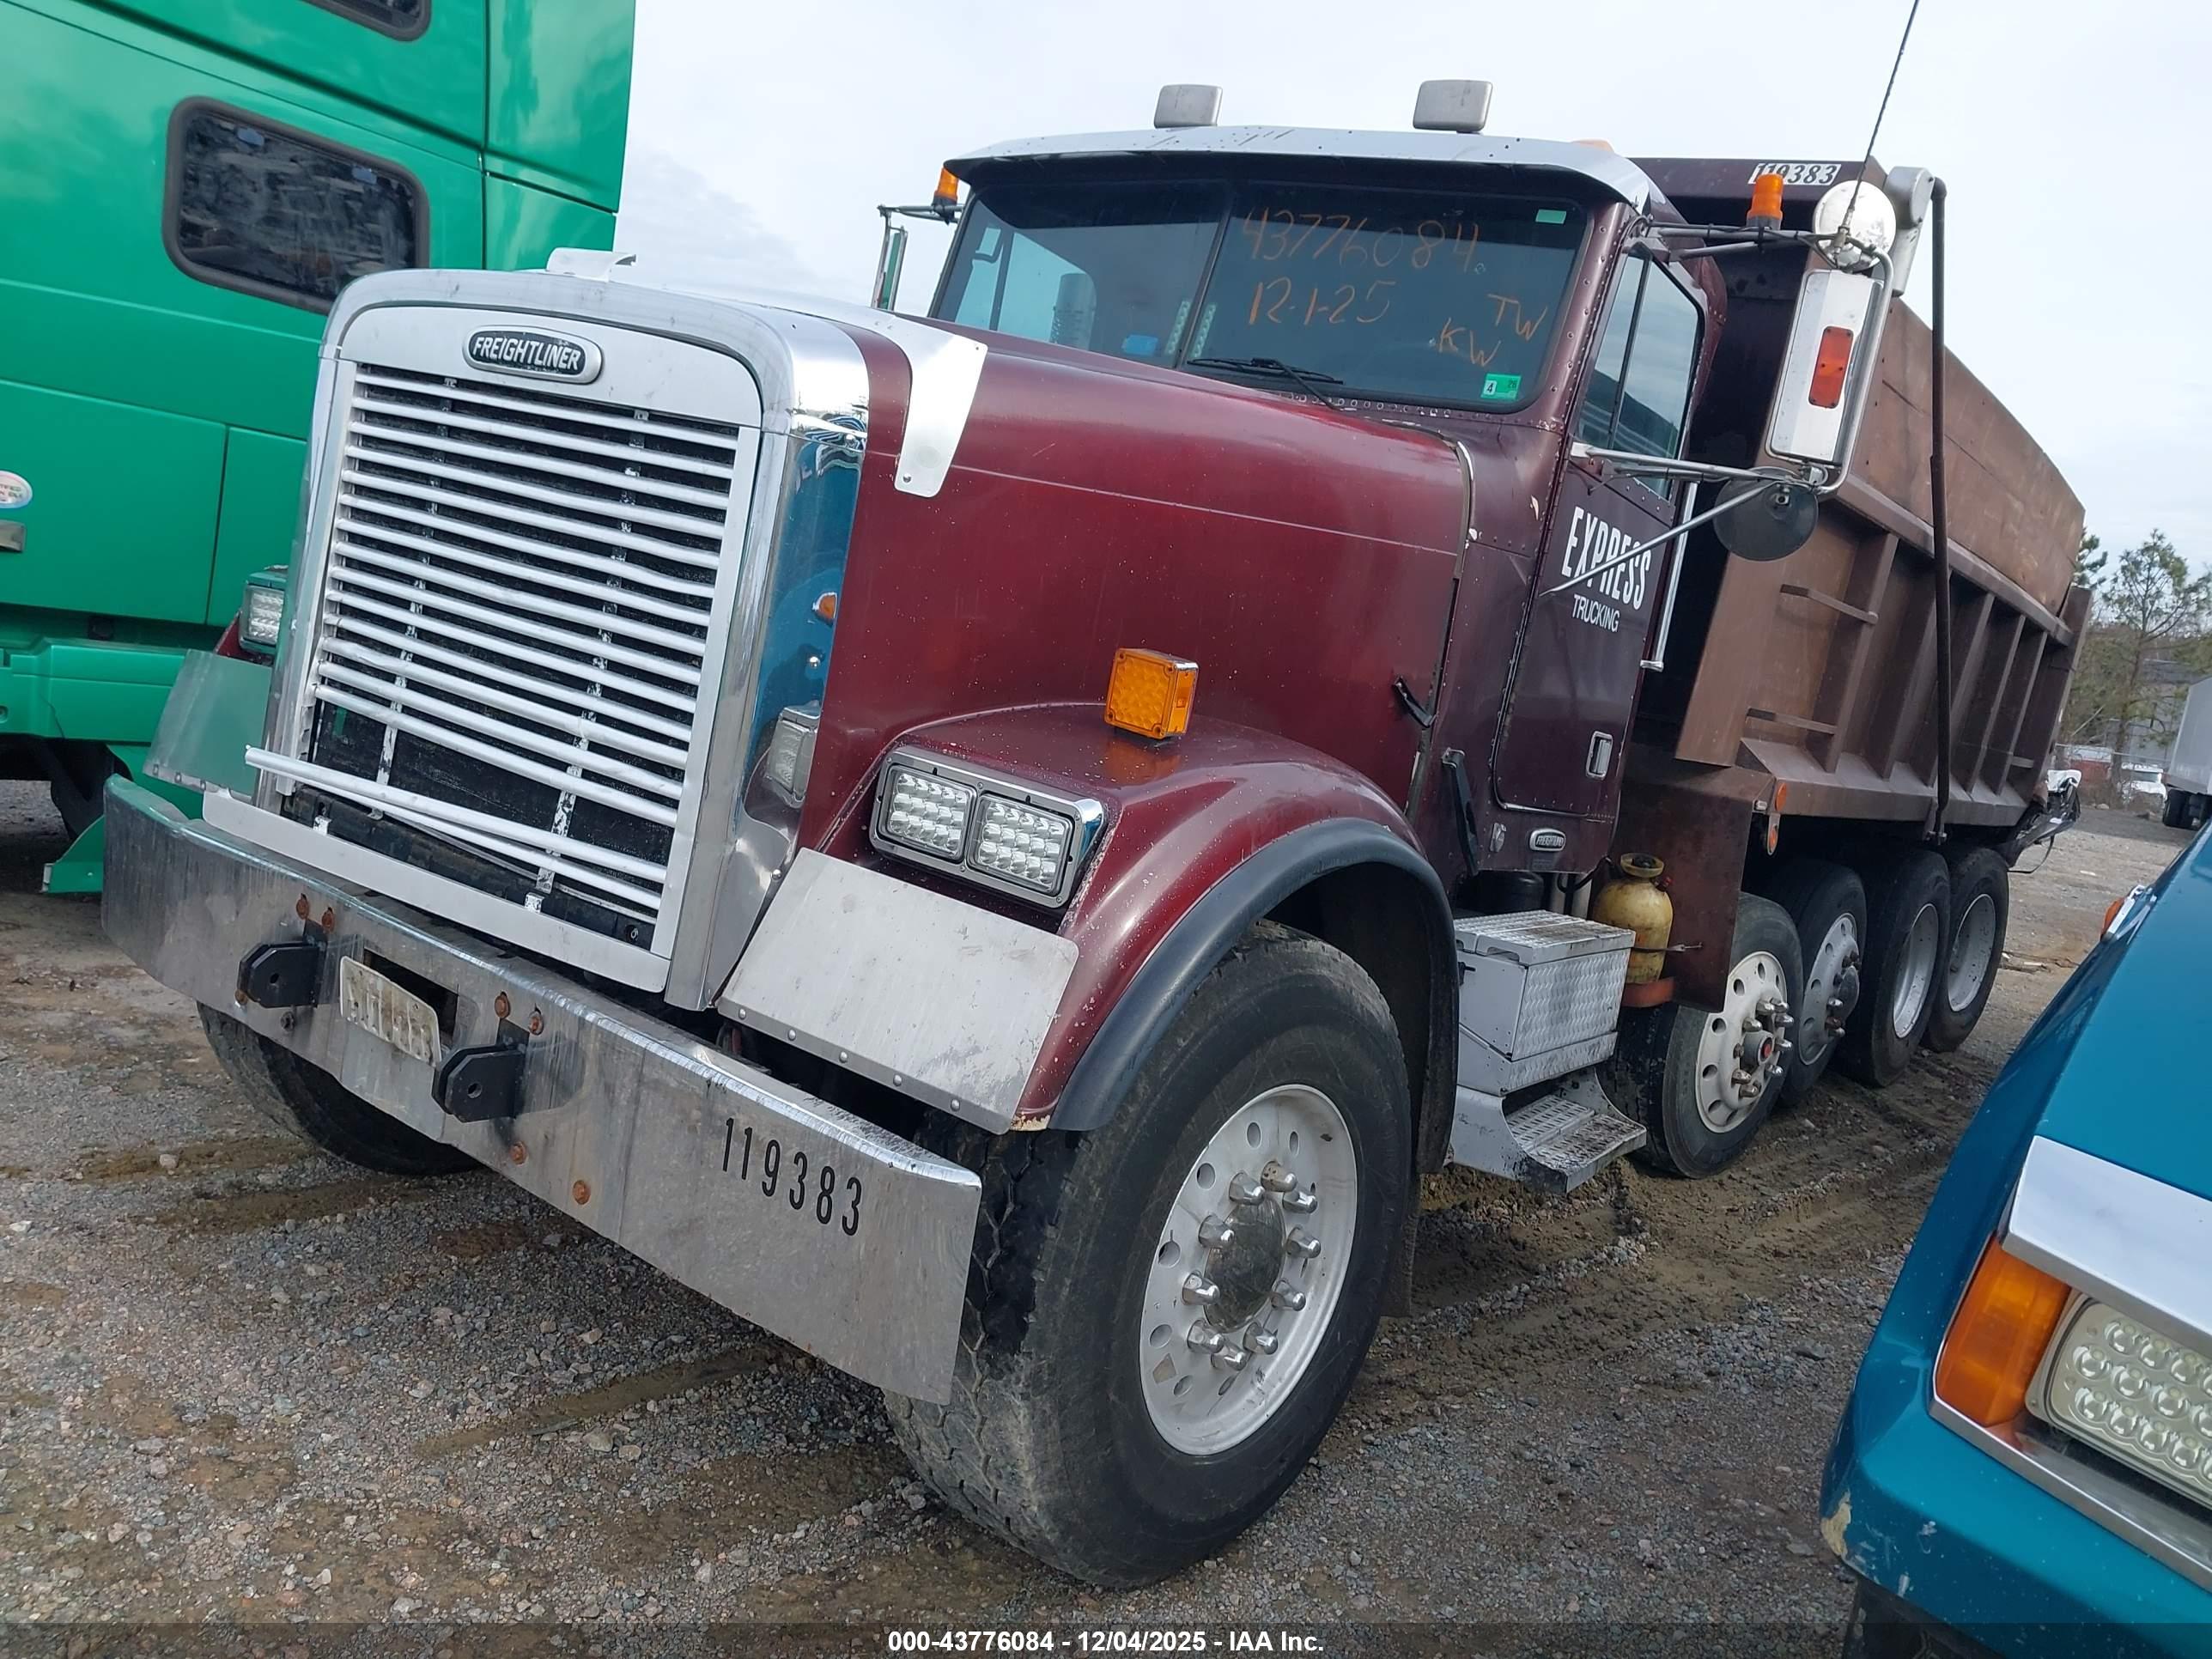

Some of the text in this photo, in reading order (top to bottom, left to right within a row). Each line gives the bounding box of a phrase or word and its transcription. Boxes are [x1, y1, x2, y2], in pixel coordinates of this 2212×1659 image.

[1242, 207, 1480, 273] 43776084
[1437, 317, 1502, 368] KW
[1487, 293, 1548, 341] TW
[472, 336, 581, 371] FREIGHTLINER
[1561, 506, 1652, 611] EXPRESS
[1572, 593, 1621, 633] TRUCKING
[722, 1117, 862, 1237] 119383
